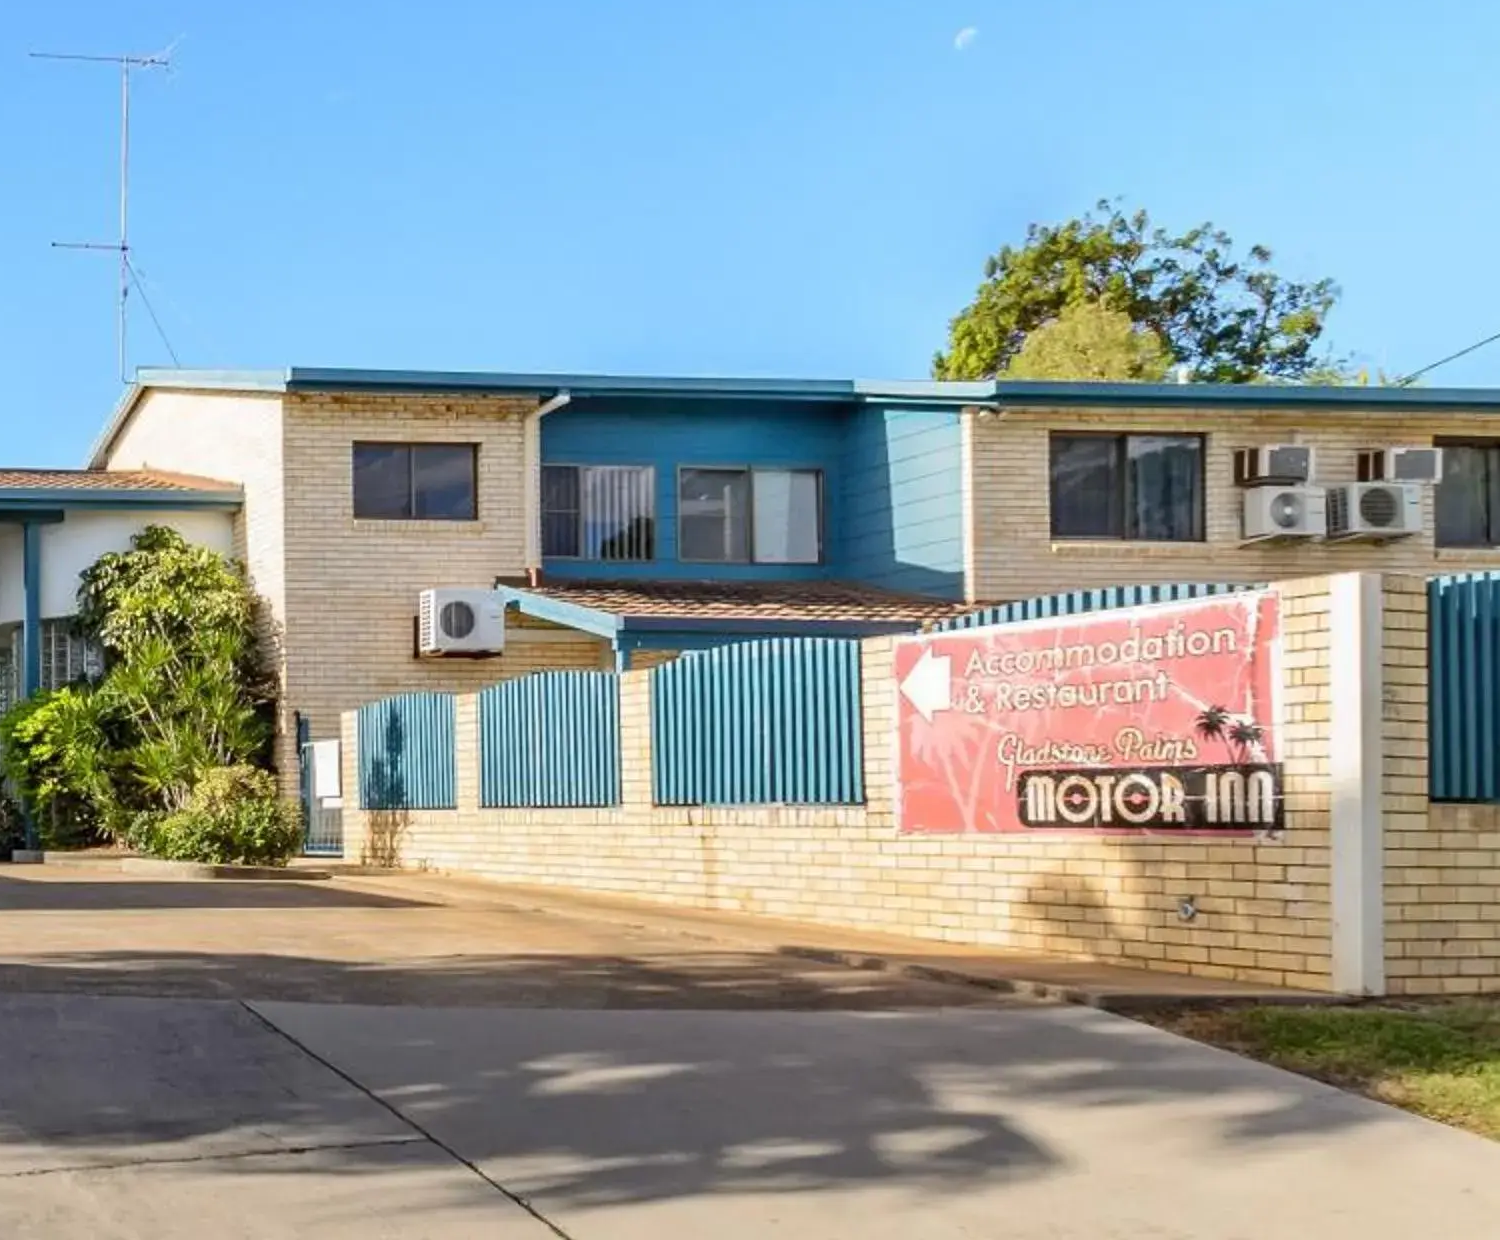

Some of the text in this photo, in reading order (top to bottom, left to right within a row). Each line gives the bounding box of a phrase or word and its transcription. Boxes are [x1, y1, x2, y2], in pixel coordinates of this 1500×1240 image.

[963, 621, 1238, 677] Accommodation
[964, 670, 1169, 714] & Restaurant
[997, 726, 1198, 792] Gladstone Palms
[1027, 770, 1275, 824] MOTOR INN
